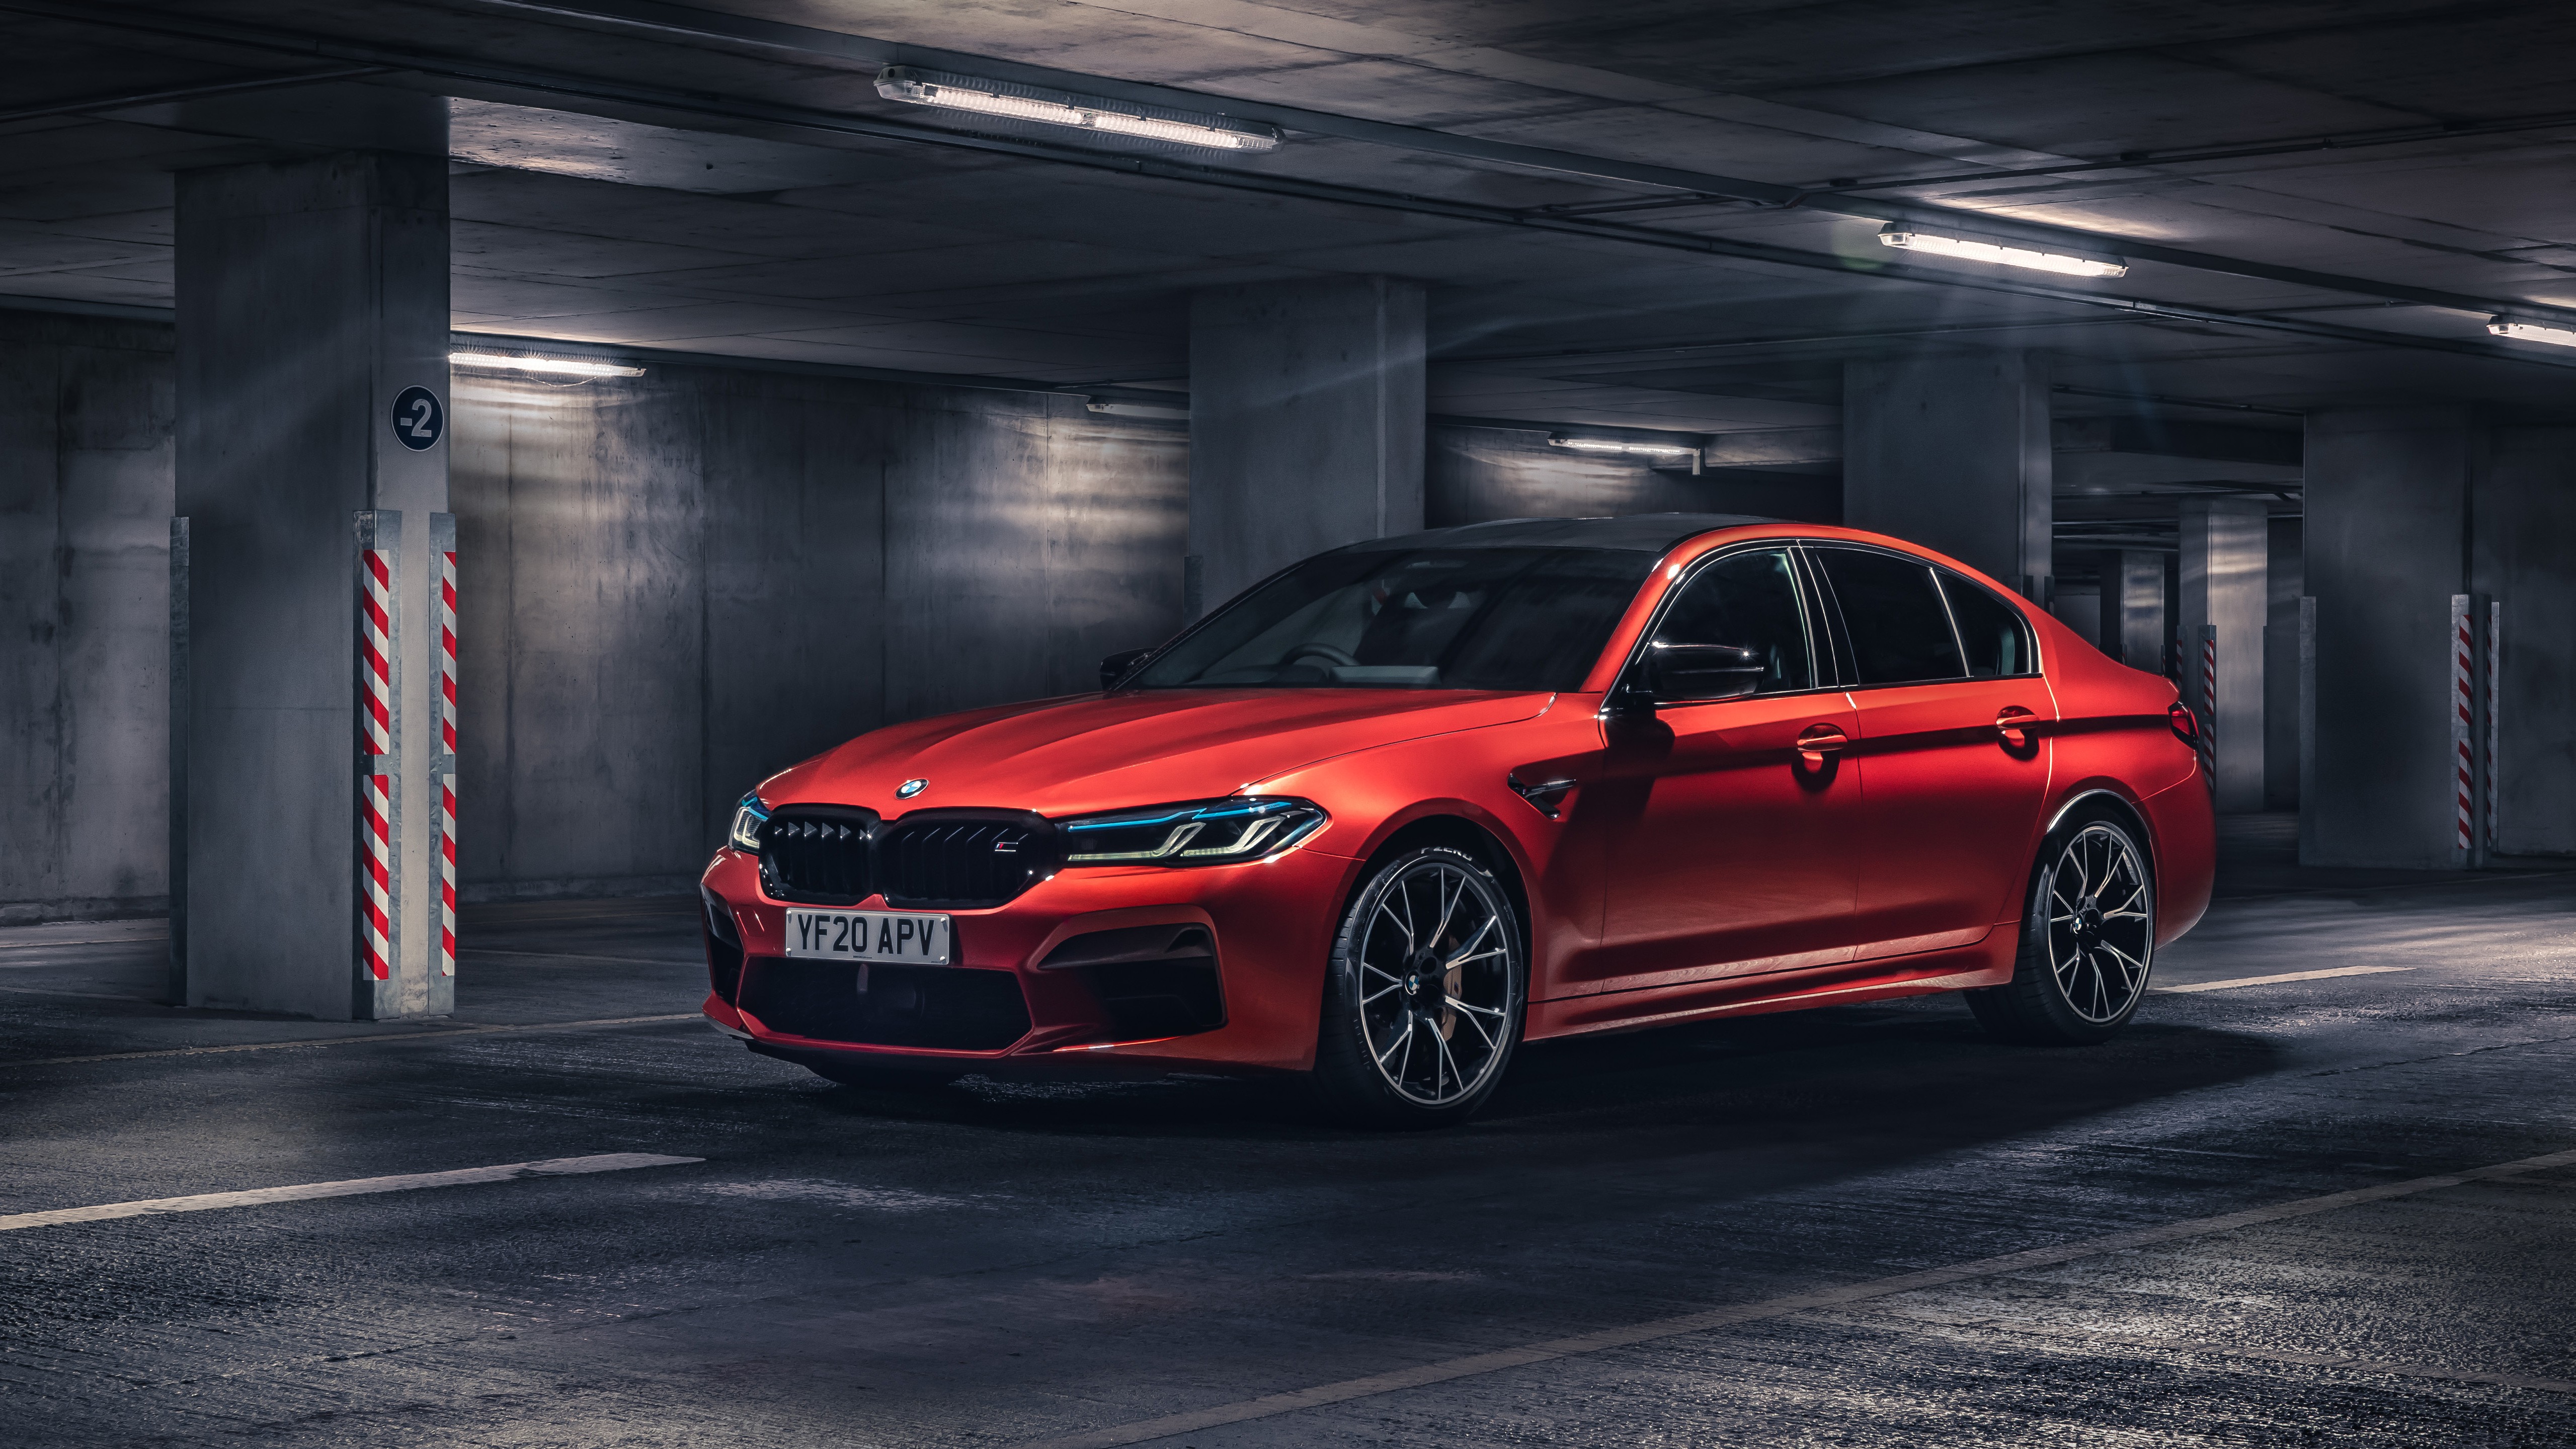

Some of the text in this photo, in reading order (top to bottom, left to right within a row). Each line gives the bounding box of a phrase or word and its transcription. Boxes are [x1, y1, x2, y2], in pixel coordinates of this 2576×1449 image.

[400, 398, 432, 437] -2
[797, 914, 934, 955] YF20 APV
